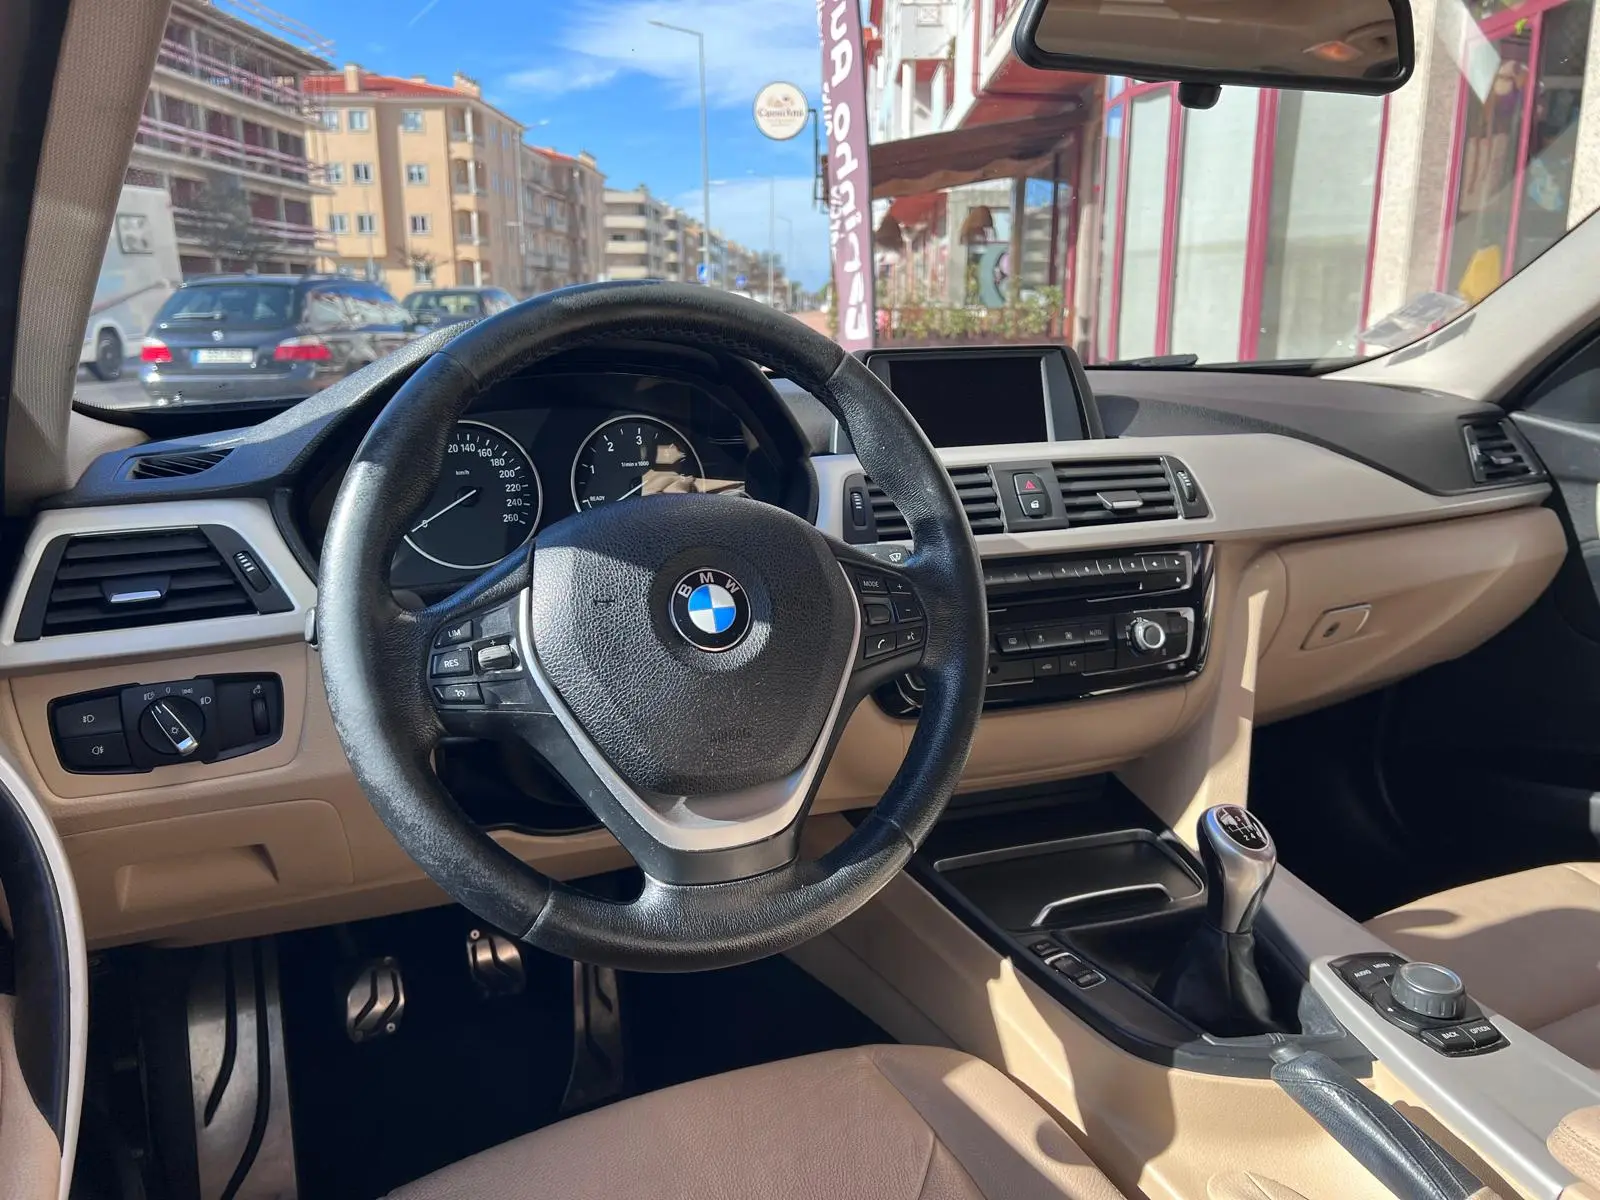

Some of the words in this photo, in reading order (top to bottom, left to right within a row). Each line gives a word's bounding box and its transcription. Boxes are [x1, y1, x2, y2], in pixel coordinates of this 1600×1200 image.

[635, 435, 643, 445] 3
[447, 444, 458, 453] 20
[460, 443, 475, 452] 140
[607, 442, 614, 452] 2
[477, 448, 492, 457] 160
[490, 458, 505, 467] 180
[499, 470, 515, 478] 200
[590, 465, 595, 474] 1
[505, 484, 521, 492] 220
[506, 498, 522, 507] 240
[503, 514, 519, 522] 260
[678, 572, 740, 598] BMW
[863, 580, 879, 588] MODE
[447, 629, 461, 638] LIM
[443, 659, 459, 668] RES
[1353, 969, 1371, 978] AUDIO
[1469, 1025, 1491, 1034] OPTION
[1441, 1031, 1460, 1040] BACK
